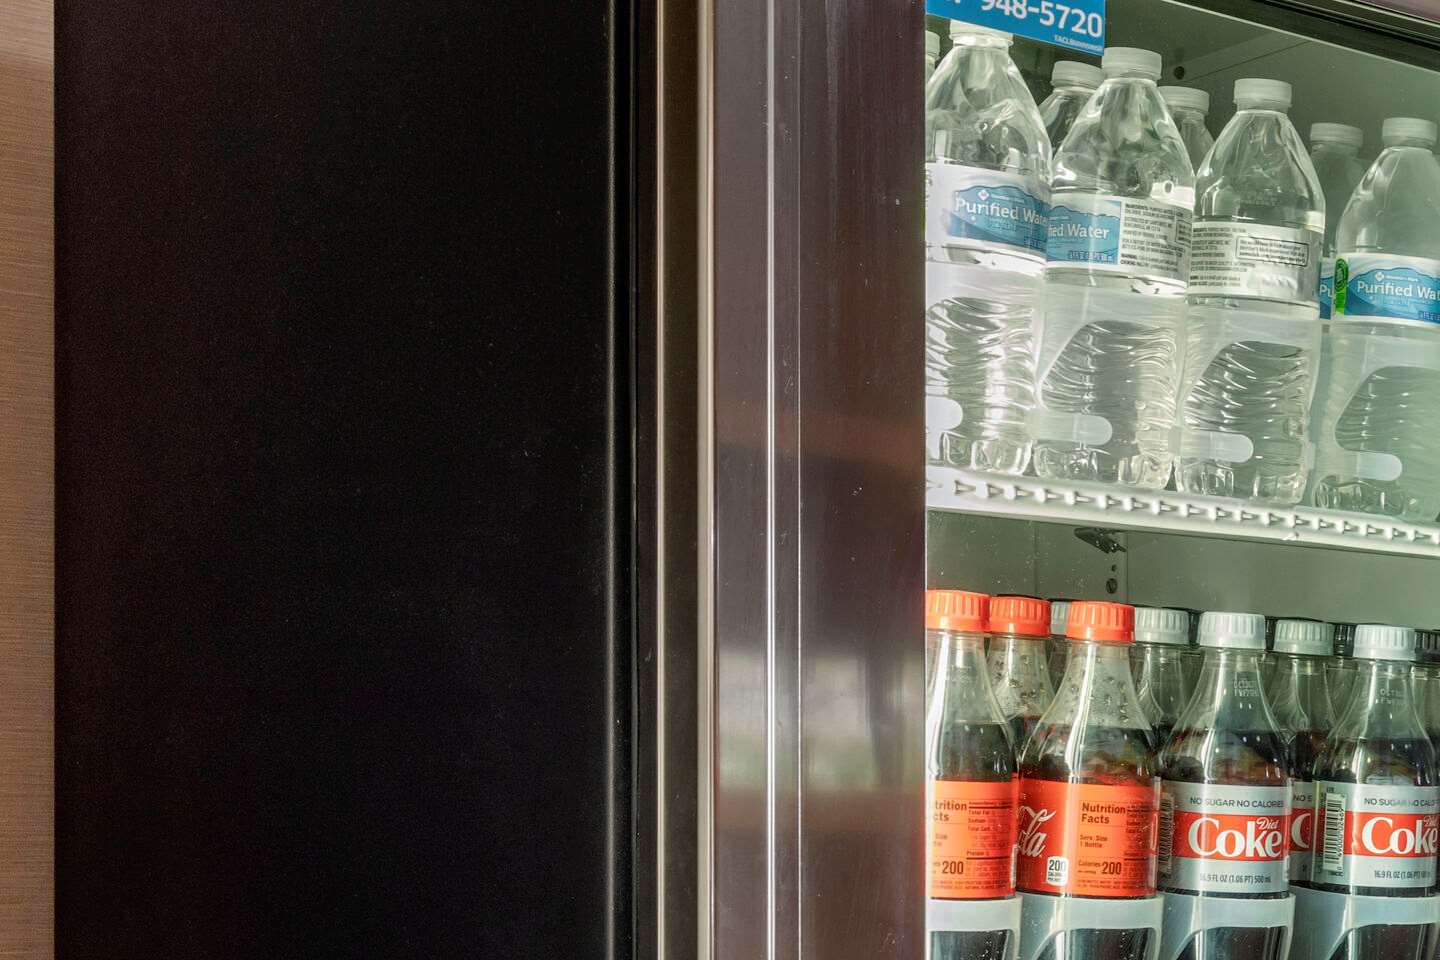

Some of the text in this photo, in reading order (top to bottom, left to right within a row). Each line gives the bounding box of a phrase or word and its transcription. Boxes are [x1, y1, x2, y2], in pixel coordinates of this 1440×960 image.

[955, 196, 1018, 219] Purified
[1067, 223, 1110, 239] Water
[1357, 281, 1413, 297] Purified
[935, 800, 968, 811] trition
[1082, 802, 1126, 814] Nutrition
[1237, 799, 1250, 808] NO
[1364, 797, 1378, 805] NO
[933, 813, 949, 822] cts
[1081, 813, 1110, 824] Facts
[1256, 816, 1279, 830] Diet
[1188, 817, 1282, 858] Coke
[1362, 817, 1438, 854] Coke
[942, 861, 964, 875] 200
[1102, 861, 1122, 875] 200
